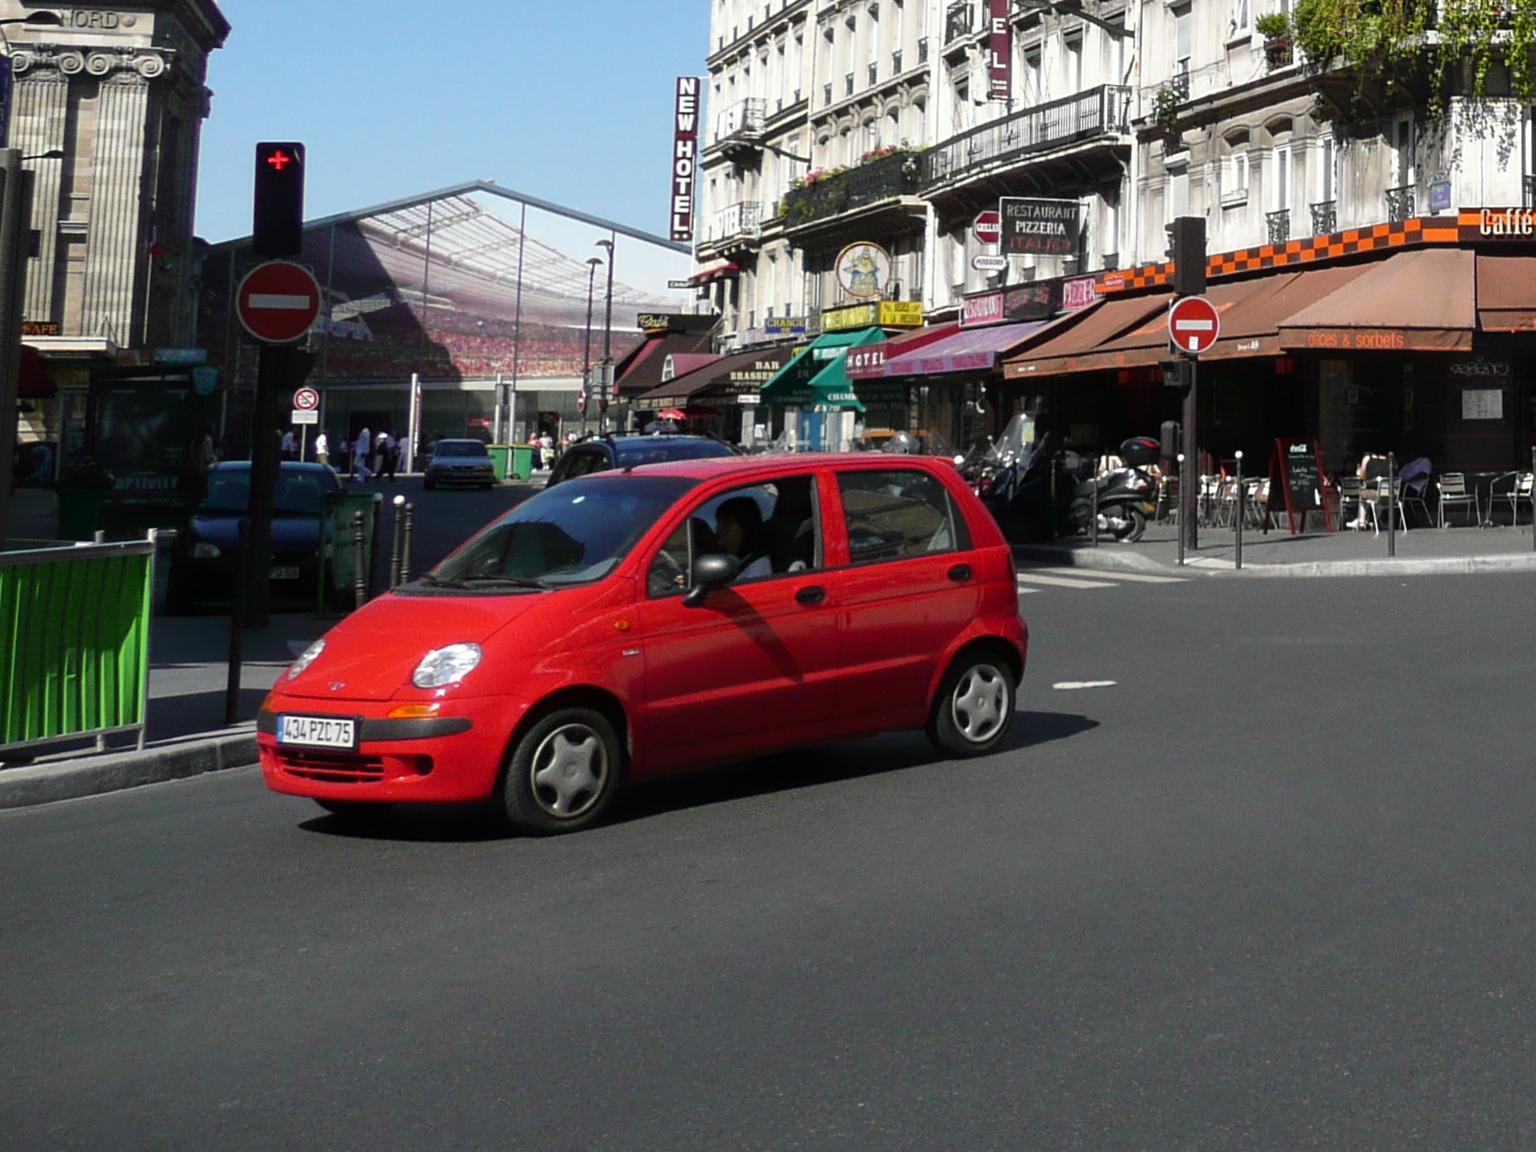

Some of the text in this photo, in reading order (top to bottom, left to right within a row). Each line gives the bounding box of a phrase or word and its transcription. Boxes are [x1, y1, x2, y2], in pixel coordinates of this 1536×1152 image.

[62, 9, 119, 29] NORD
[673, 78, 696, 231] NEW HOTEL
[1006, 204, 1077, 219] RESTAURANT
[1015, 221, 1066, 235] PIZZERIA
[1479, 208, 1533, 236] Caffé
[766, 319, 804, 328] CHANGE
[1356, 332, 1404, 348] sorbets
[755, 361, 779, 370] BAR
[846, 352, 885, 367] HOTEL
[730, 371, 775, 380] BRASSER
[285, 719, 351, 744] 434 PZC 75
